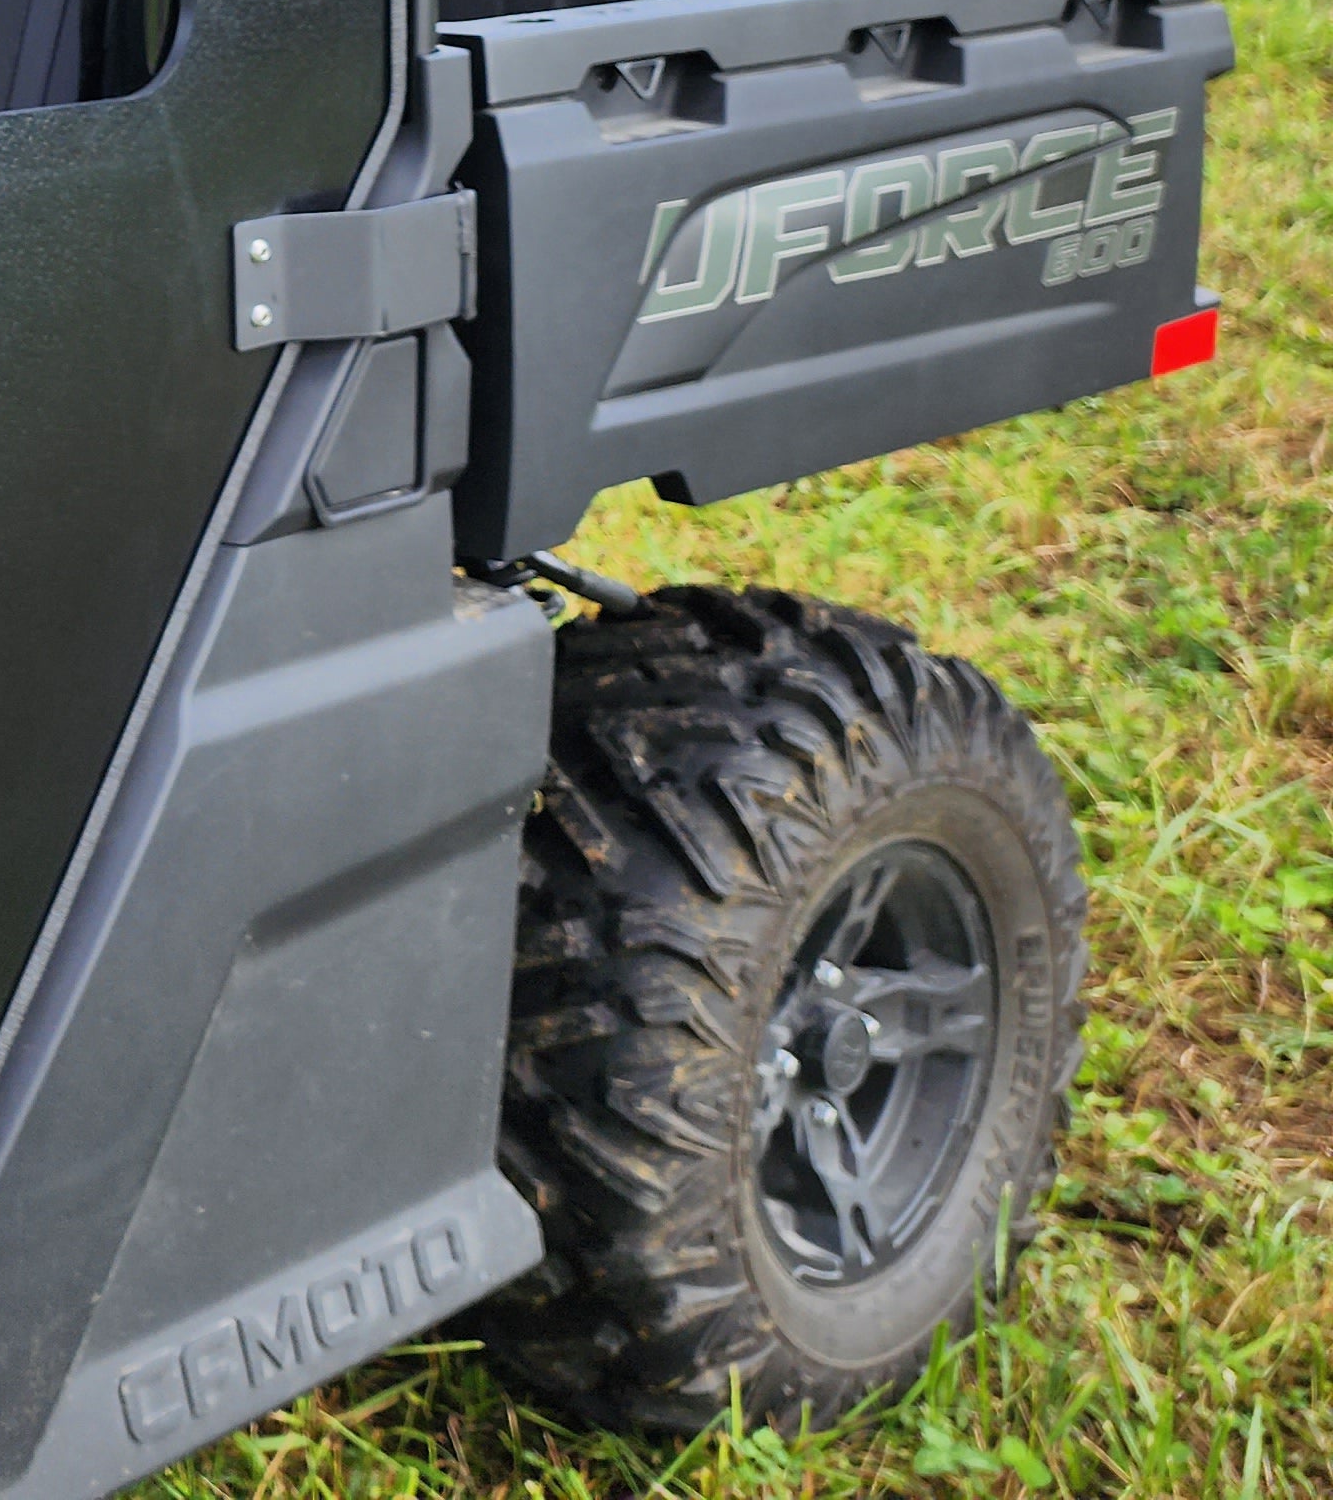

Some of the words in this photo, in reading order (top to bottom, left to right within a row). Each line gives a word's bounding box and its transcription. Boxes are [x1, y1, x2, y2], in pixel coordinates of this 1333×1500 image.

[636, 107, 1178, 324] UFORCE
[1041, 214, 1157, 287] 600
[117, 1215, 467, 1445] CFMOTO
